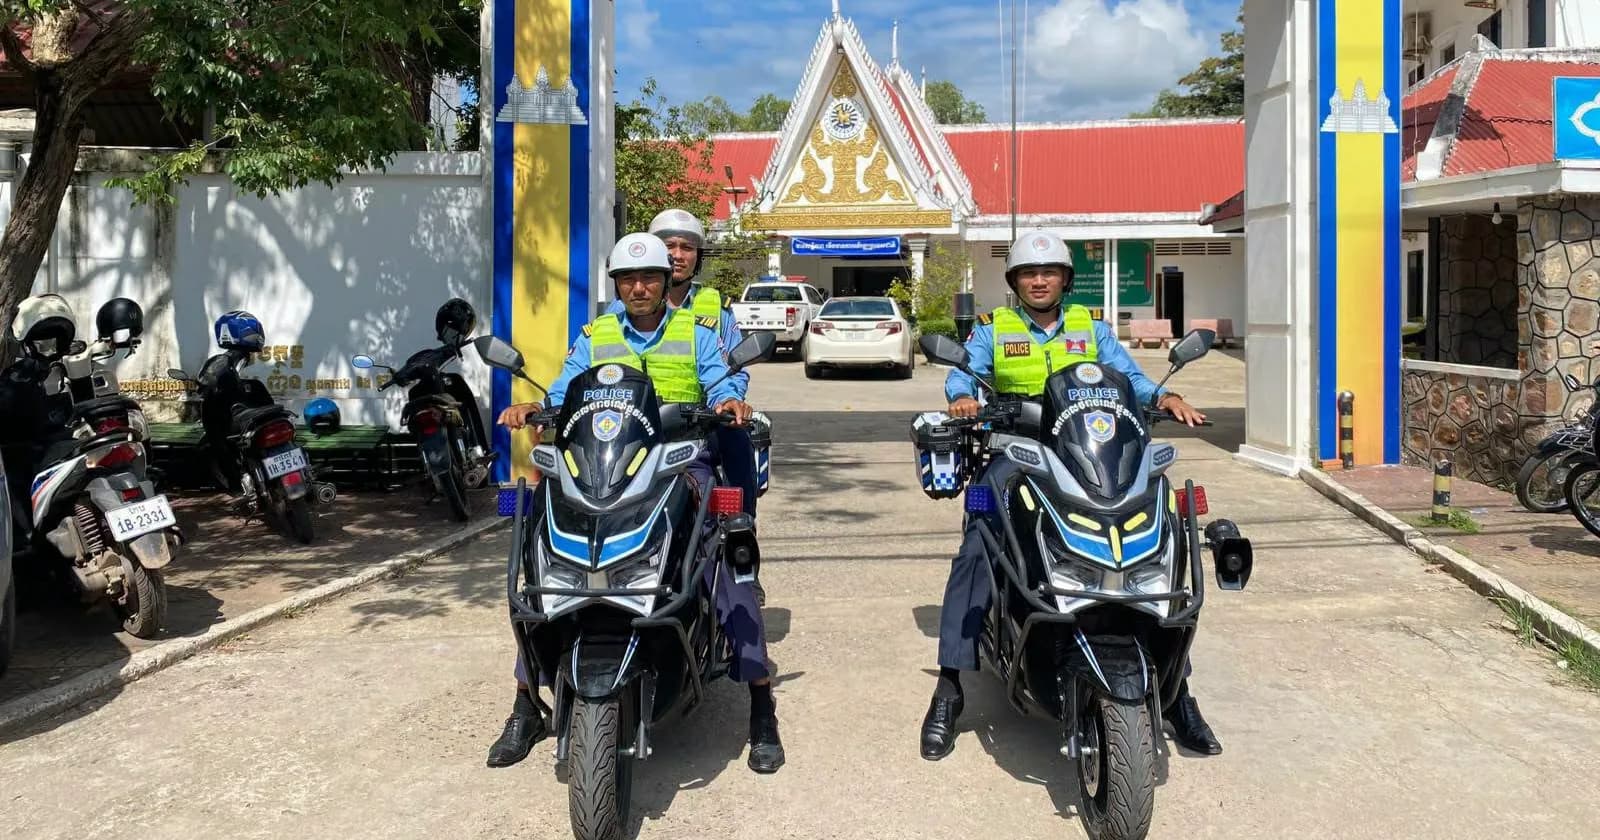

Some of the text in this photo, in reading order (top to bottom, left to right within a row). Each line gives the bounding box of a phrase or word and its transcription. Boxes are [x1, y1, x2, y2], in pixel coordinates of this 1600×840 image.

[1005, 343, 1030, 355] POLICE
[583, 388, 633, 401] POLICE
[1068, 387, 1119, 400] POLICE
